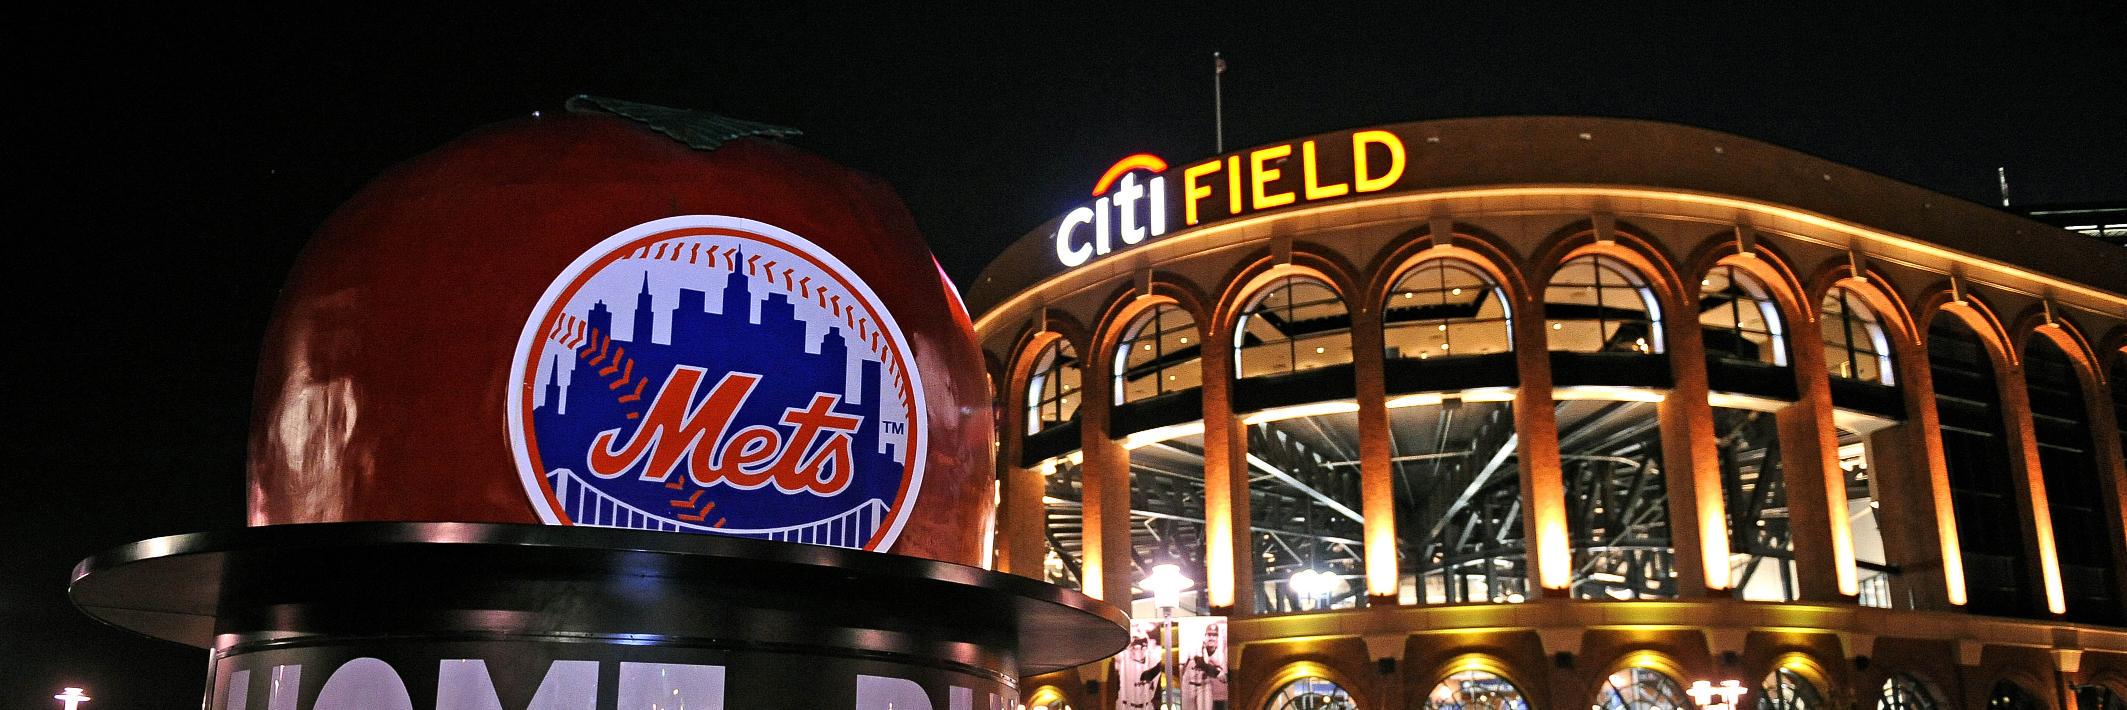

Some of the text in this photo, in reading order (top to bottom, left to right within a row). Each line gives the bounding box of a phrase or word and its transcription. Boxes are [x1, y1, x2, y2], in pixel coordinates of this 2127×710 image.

[1056, 129, 1406, 268] citi FIELD
[587, 363, 865, 497] Mets
[882, 420, 904, 435] TM
